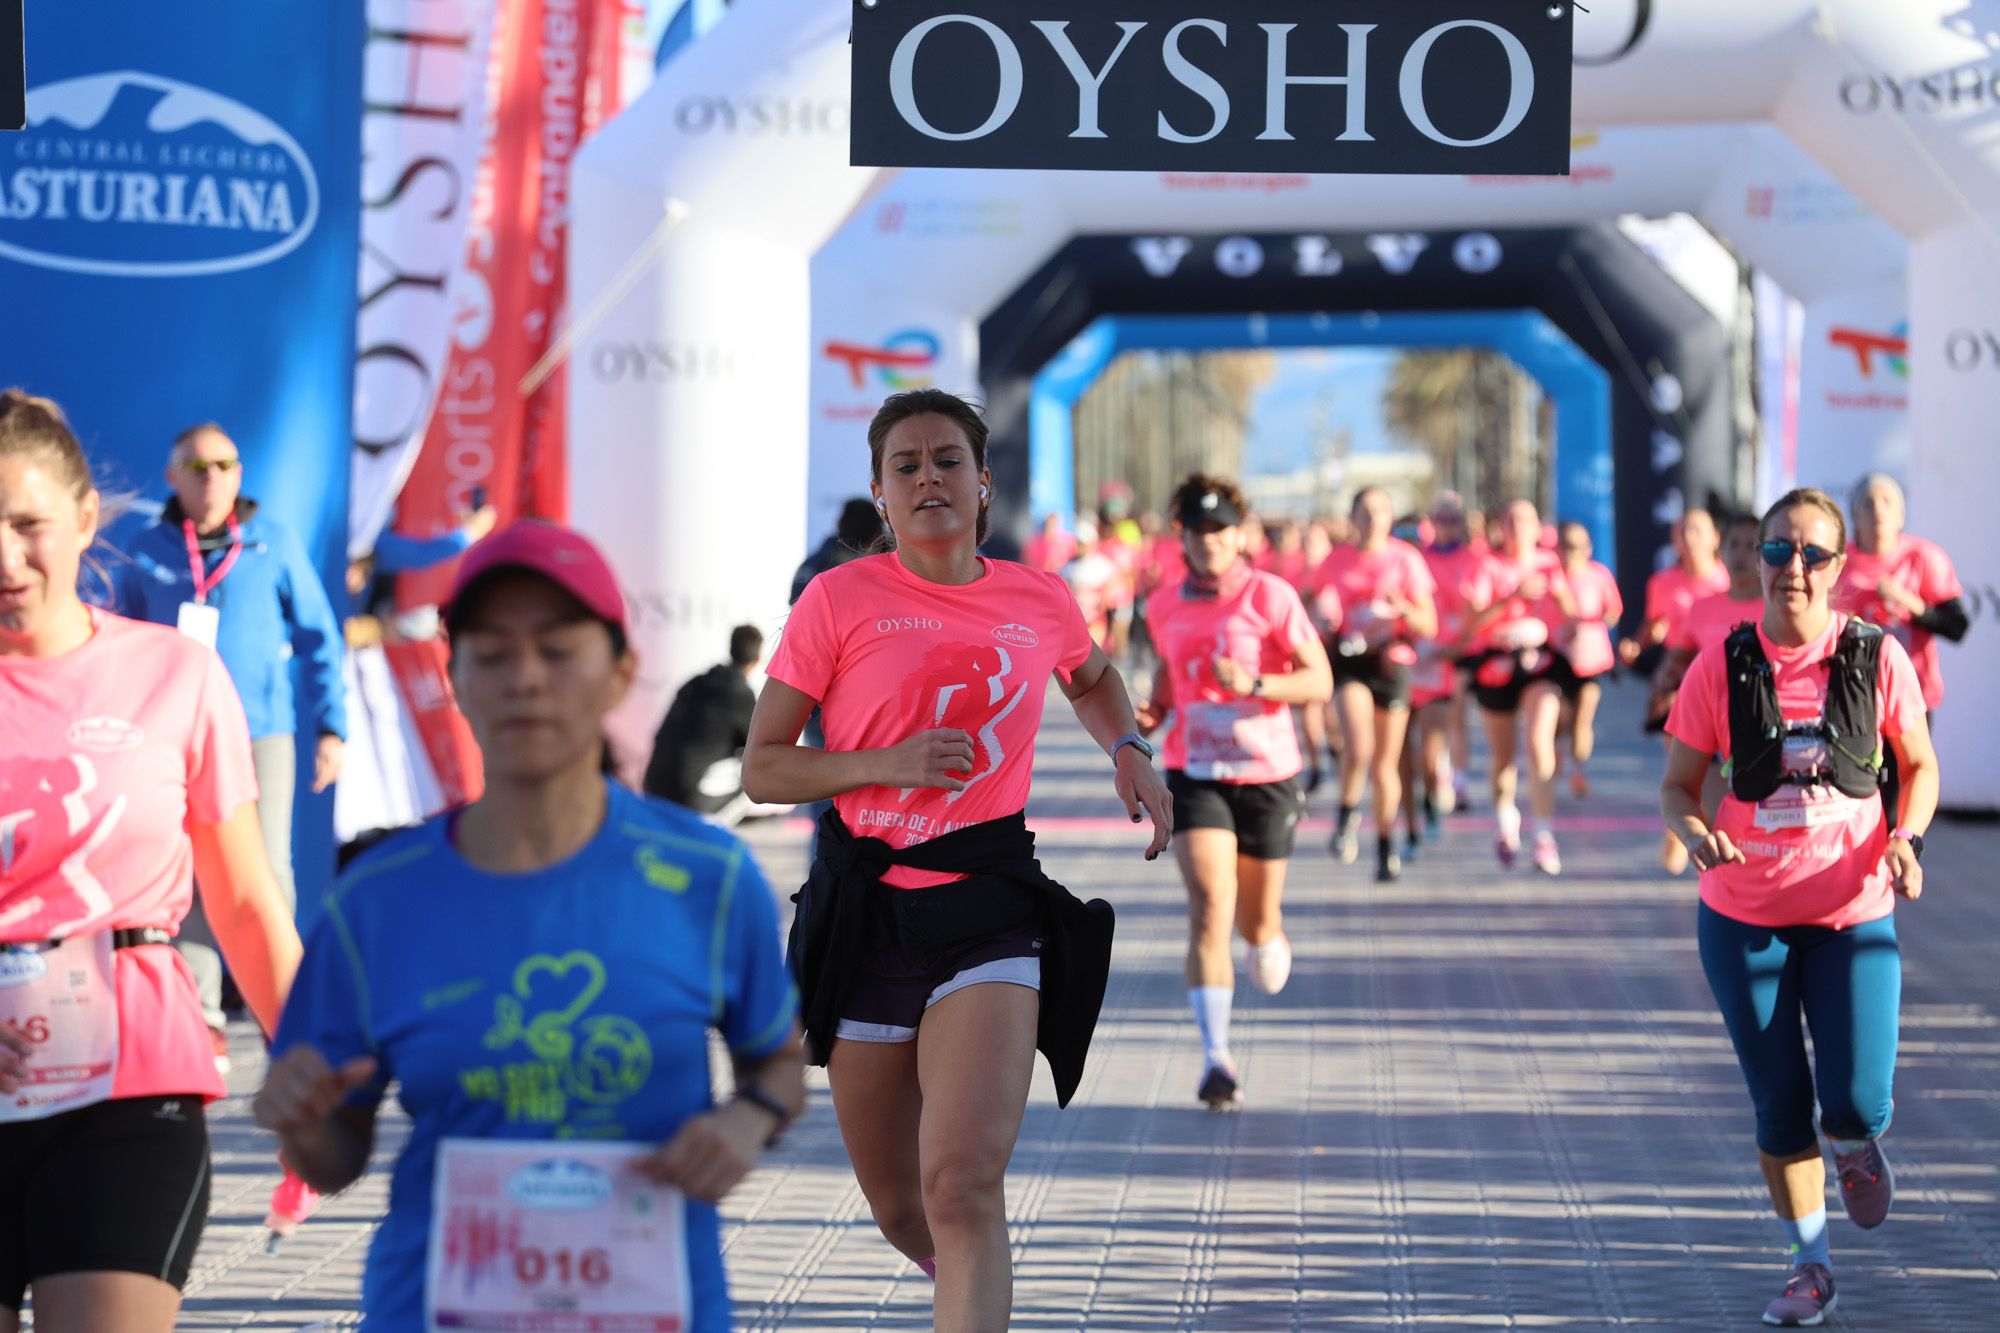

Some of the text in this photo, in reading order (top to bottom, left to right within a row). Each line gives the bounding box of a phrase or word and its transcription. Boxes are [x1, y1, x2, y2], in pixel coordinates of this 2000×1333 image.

[888, 14, 1535, 148] OYSHO
[1131, 232, 1503, 279] VOLVO
[877, 617, 942, 633] OYSHO
[908, 813, 929, 834] DE
[515, 1247, 611, 1288] 016
